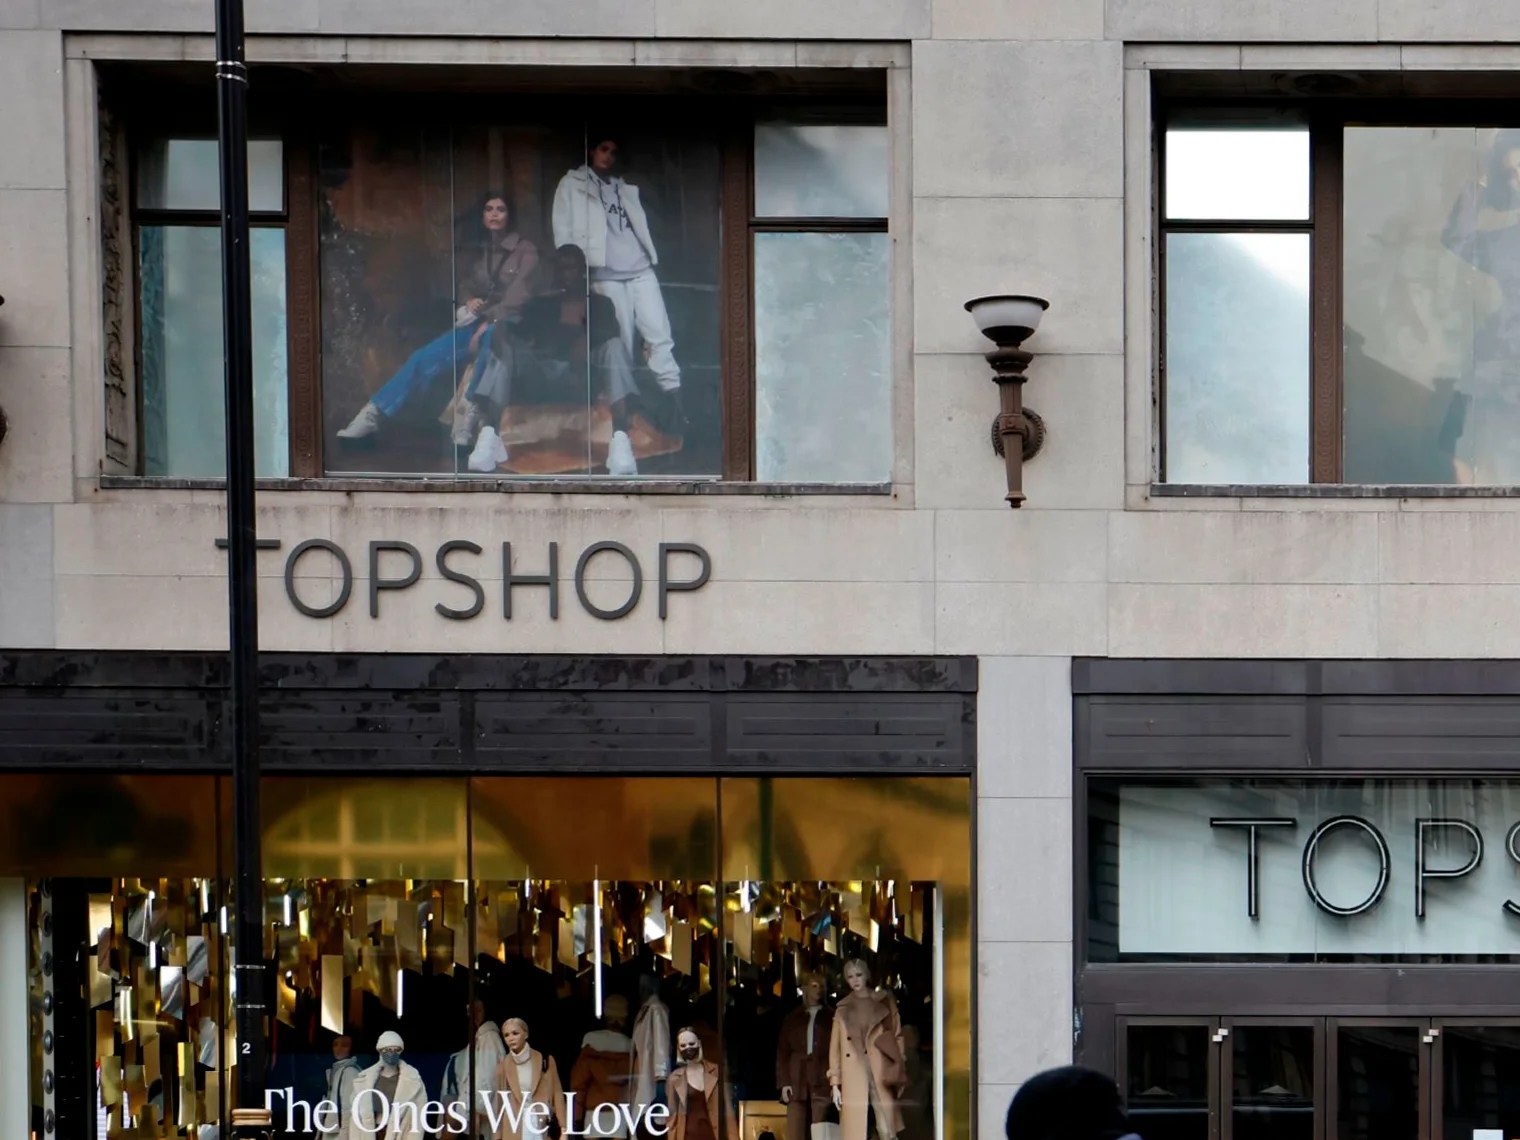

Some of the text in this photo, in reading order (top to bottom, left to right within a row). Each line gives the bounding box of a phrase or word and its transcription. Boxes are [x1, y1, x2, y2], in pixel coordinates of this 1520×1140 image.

[215, 537, 712, 621] OPSHOP
[241, 1042, 251, 1055] 2
[351, 1087, 468, 1134] Ones
[477, 1089, 551, 1135] We
[562, 1091, 671, 1137] Love
